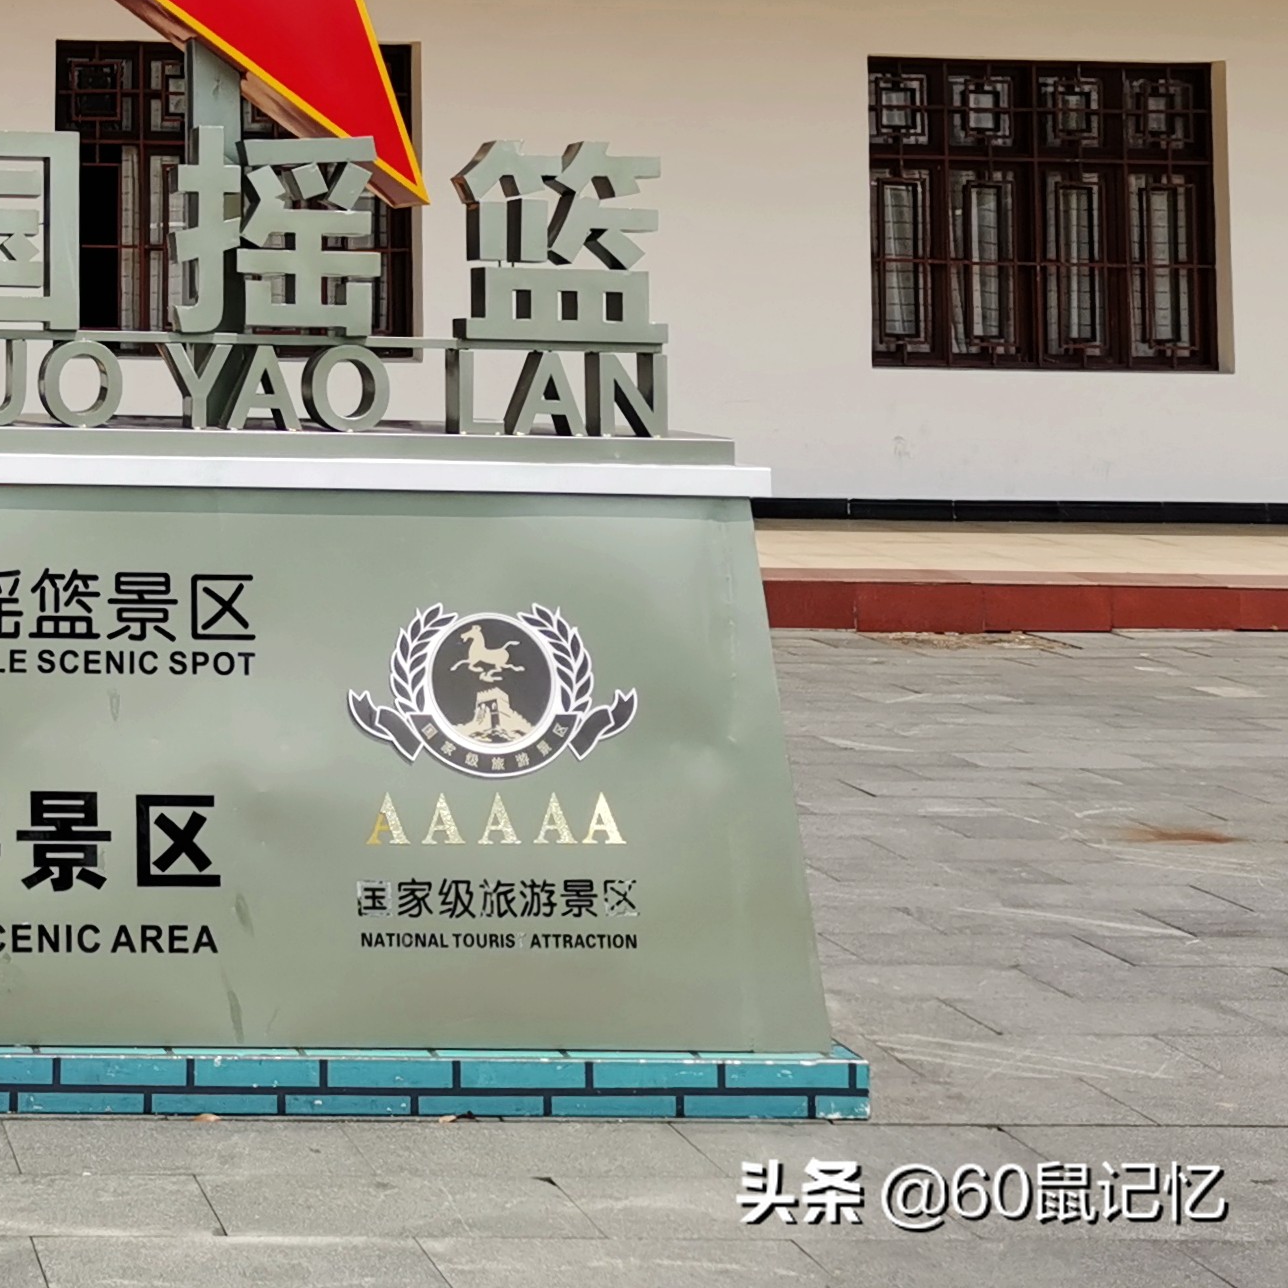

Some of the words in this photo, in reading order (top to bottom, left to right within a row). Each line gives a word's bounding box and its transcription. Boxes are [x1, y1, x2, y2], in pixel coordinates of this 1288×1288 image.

[155, 342, 390, 433] YAO
[444, 349, 668, 439] LAN
[36, 649, 159, 675] SCENIC
[169, 650, 256, 677] SPOT
[420, 722, 570, 772] 国家级旅游景区
[357, 877, 641, 918] 国家级旅游景区
[110, 924, 219, 954] AREA
[361, 932, 450, 949] NATIONAL
[529, 933, 638, 950] ATTRACTION
